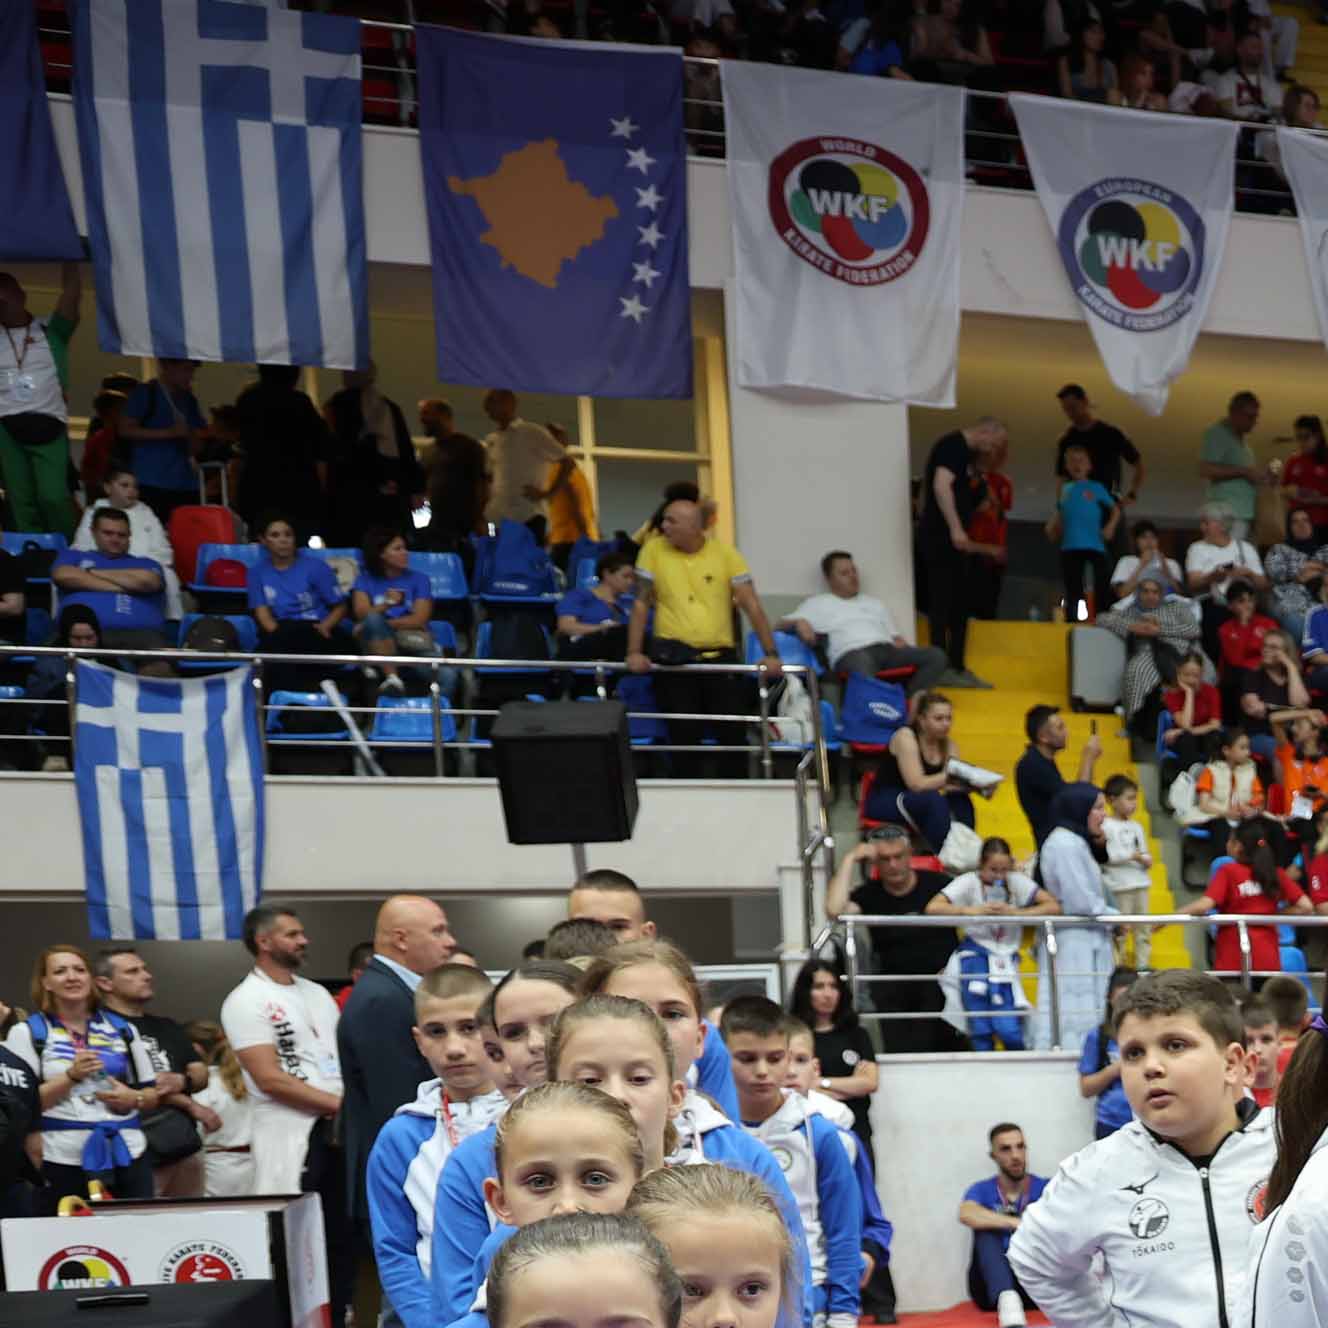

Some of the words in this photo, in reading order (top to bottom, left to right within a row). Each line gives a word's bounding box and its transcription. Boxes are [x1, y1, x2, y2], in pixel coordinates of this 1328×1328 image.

[807, 188, 889, 223] WKF
[783, 228, 833, 271] KARATE
[1097, 234, 1177, 273] WKF
